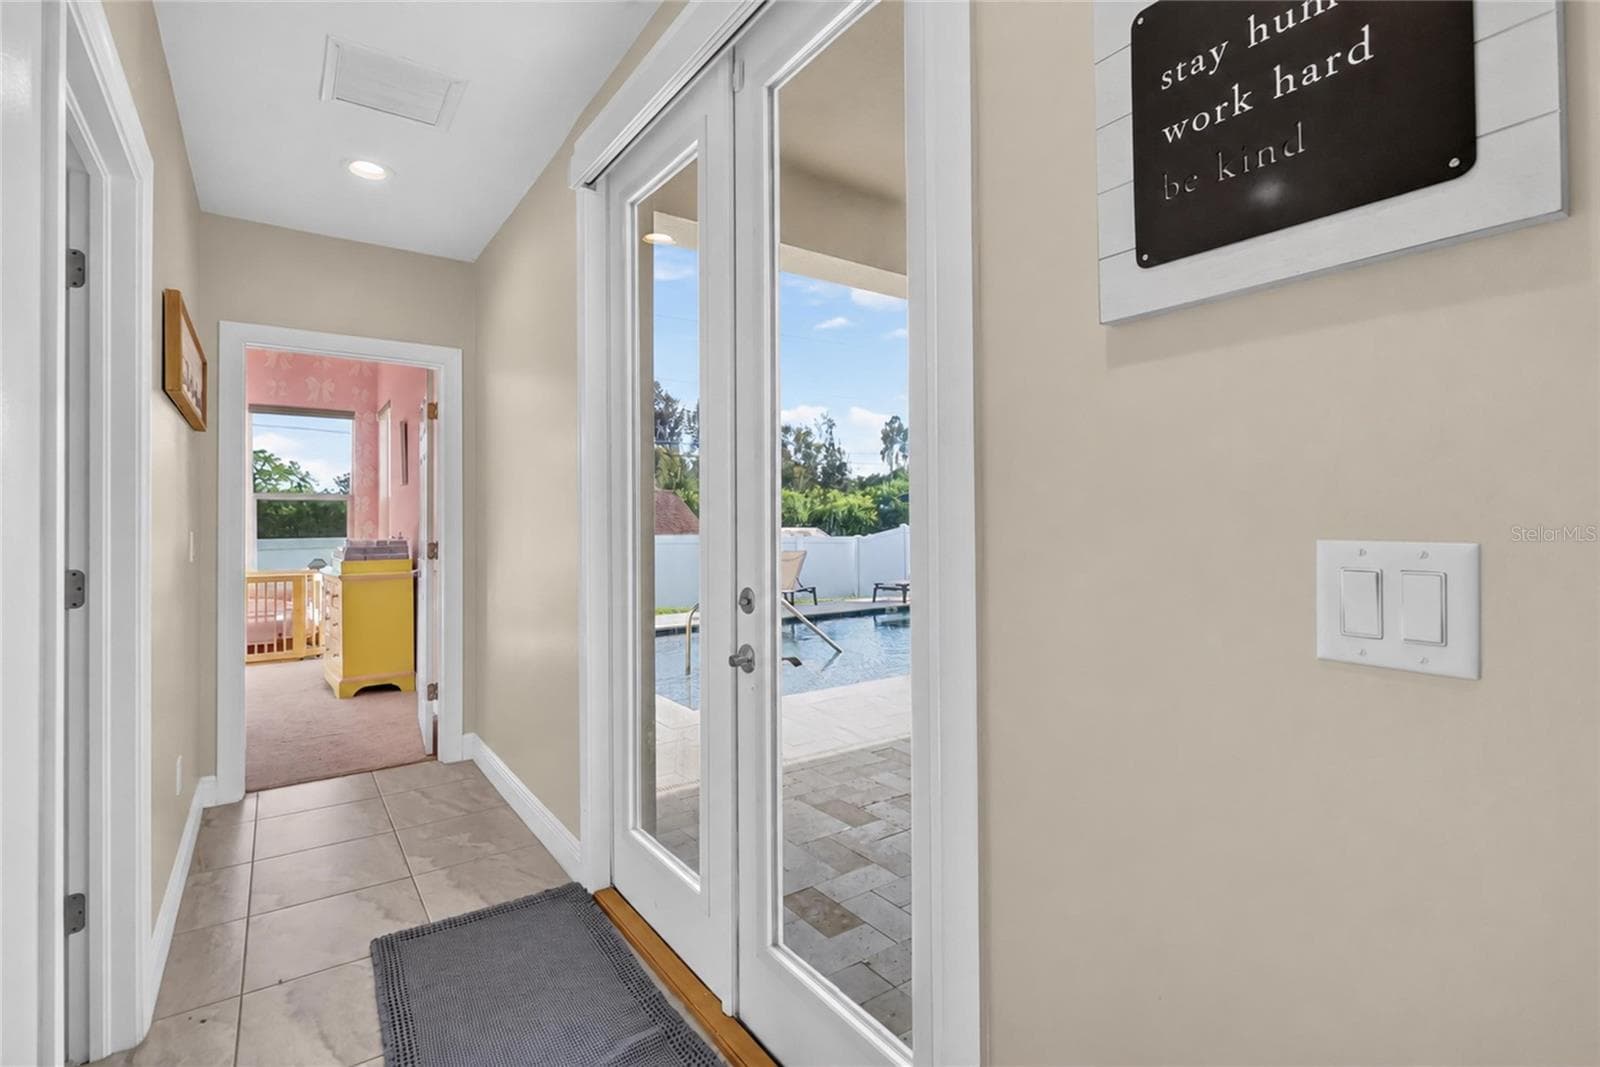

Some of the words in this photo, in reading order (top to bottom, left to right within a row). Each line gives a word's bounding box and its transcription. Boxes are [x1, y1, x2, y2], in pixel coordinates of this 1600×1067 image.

[1161, 40, 1229, 90] stay
[1162, 84, 1253, 144] work
[1273, 25, 1374, 100] hard
[1163, 172, 1198, 200] be
[1217, 121, 1305, 182] kind
